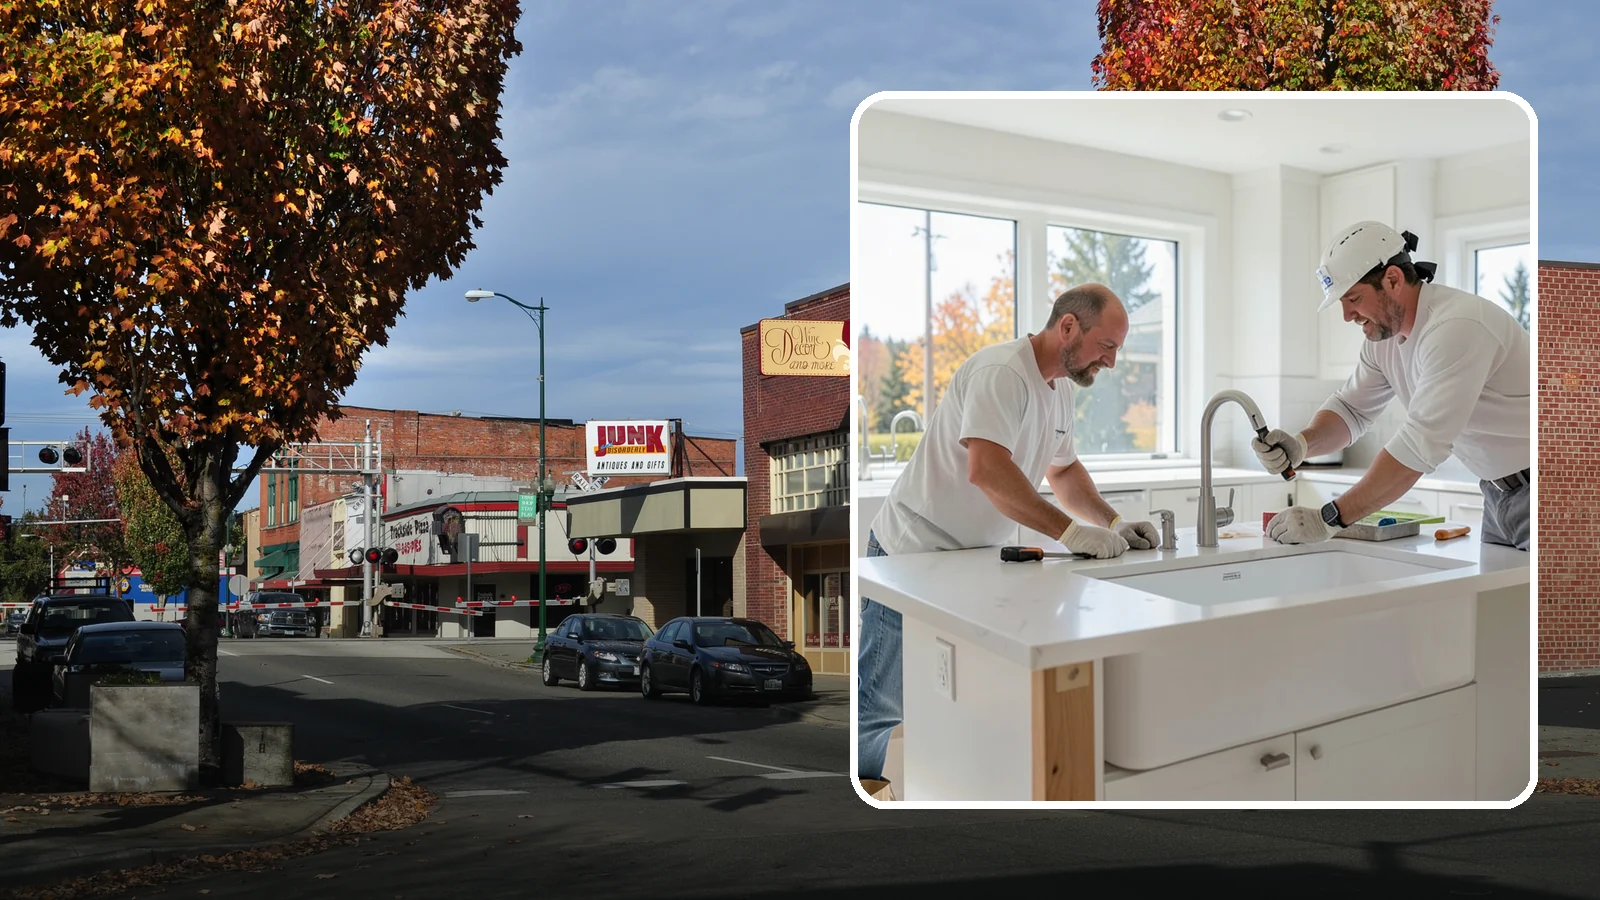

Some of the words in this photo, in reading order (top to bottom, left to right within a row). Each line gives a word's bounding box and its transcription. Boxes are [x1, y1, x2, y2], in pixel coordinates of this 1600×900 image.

[595, 425, 665, 457] JUNK
[607, 446, 646, 454] DISORDERLY
[597, 461, 628, 470] ANTIQUES
[631, 461, 644, 470] AND
[647, 460, 665, 469] GIFTS
[352, 498, 365, 510] CRO
[390, 521, 413, 539] Trackside
[414, 519, 429, 535] Pizza
